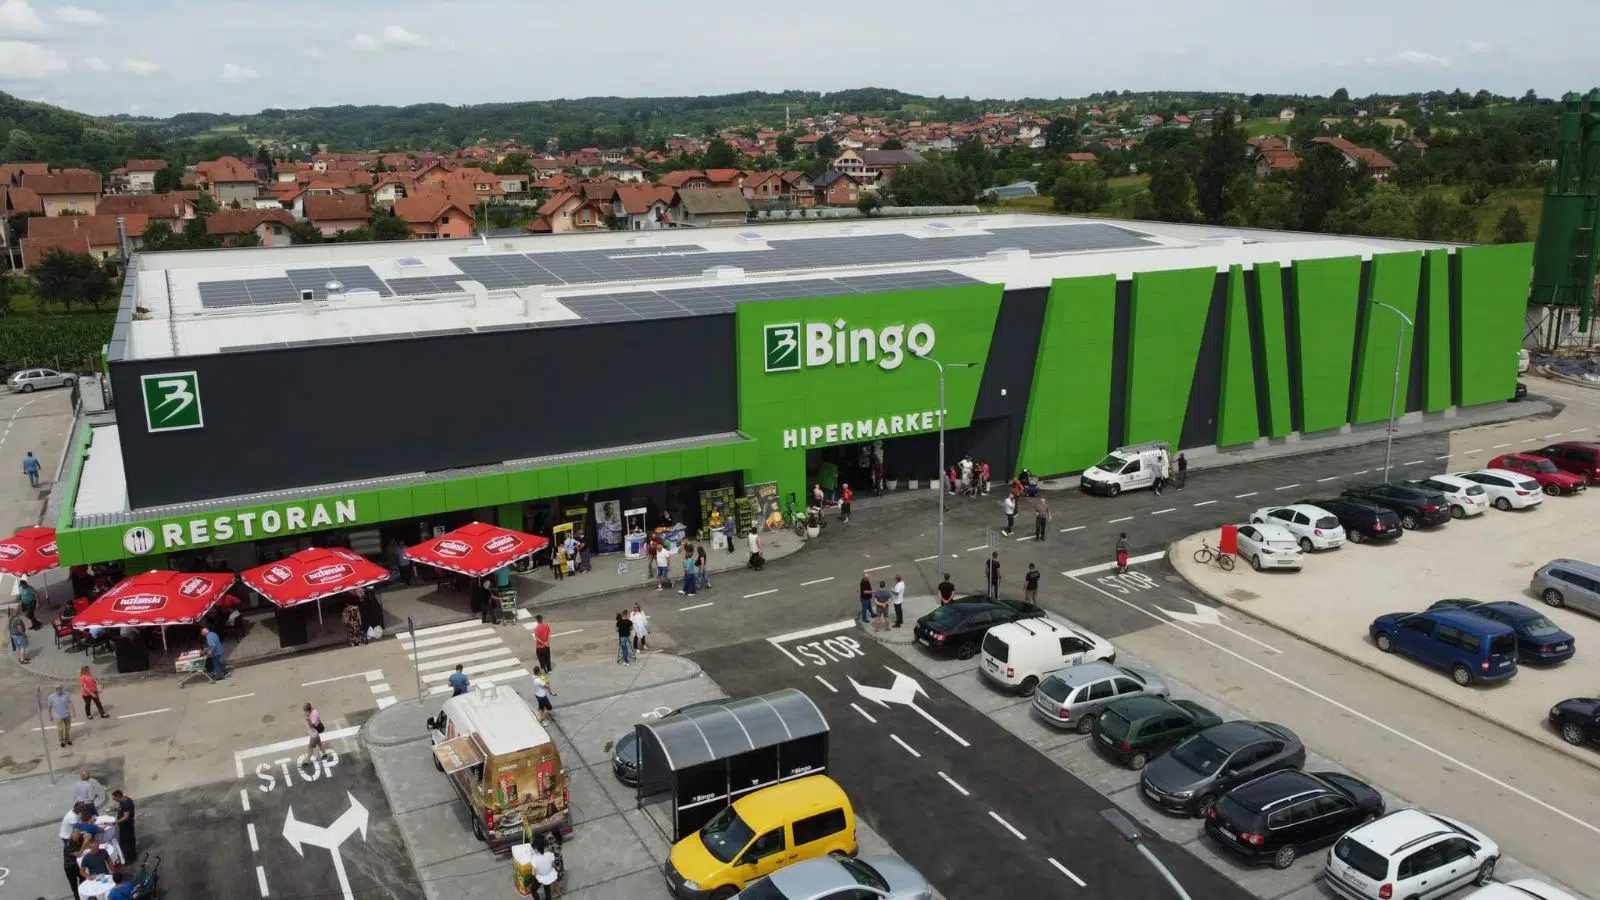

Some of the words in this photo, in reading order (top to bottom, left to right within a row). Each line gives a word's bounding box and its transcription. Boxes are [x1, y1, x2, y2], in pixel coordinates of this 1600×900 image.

[806, 318, 935, 370] Bingo
[783, 410, 947, 448] HIPERMARKET
[162, 499, 356, 548] RESTORAN
[1097, 571, 1160, 593] STOP
[796, 636, 865, 666] STOP
[256, 748, 339, 792] STOP
